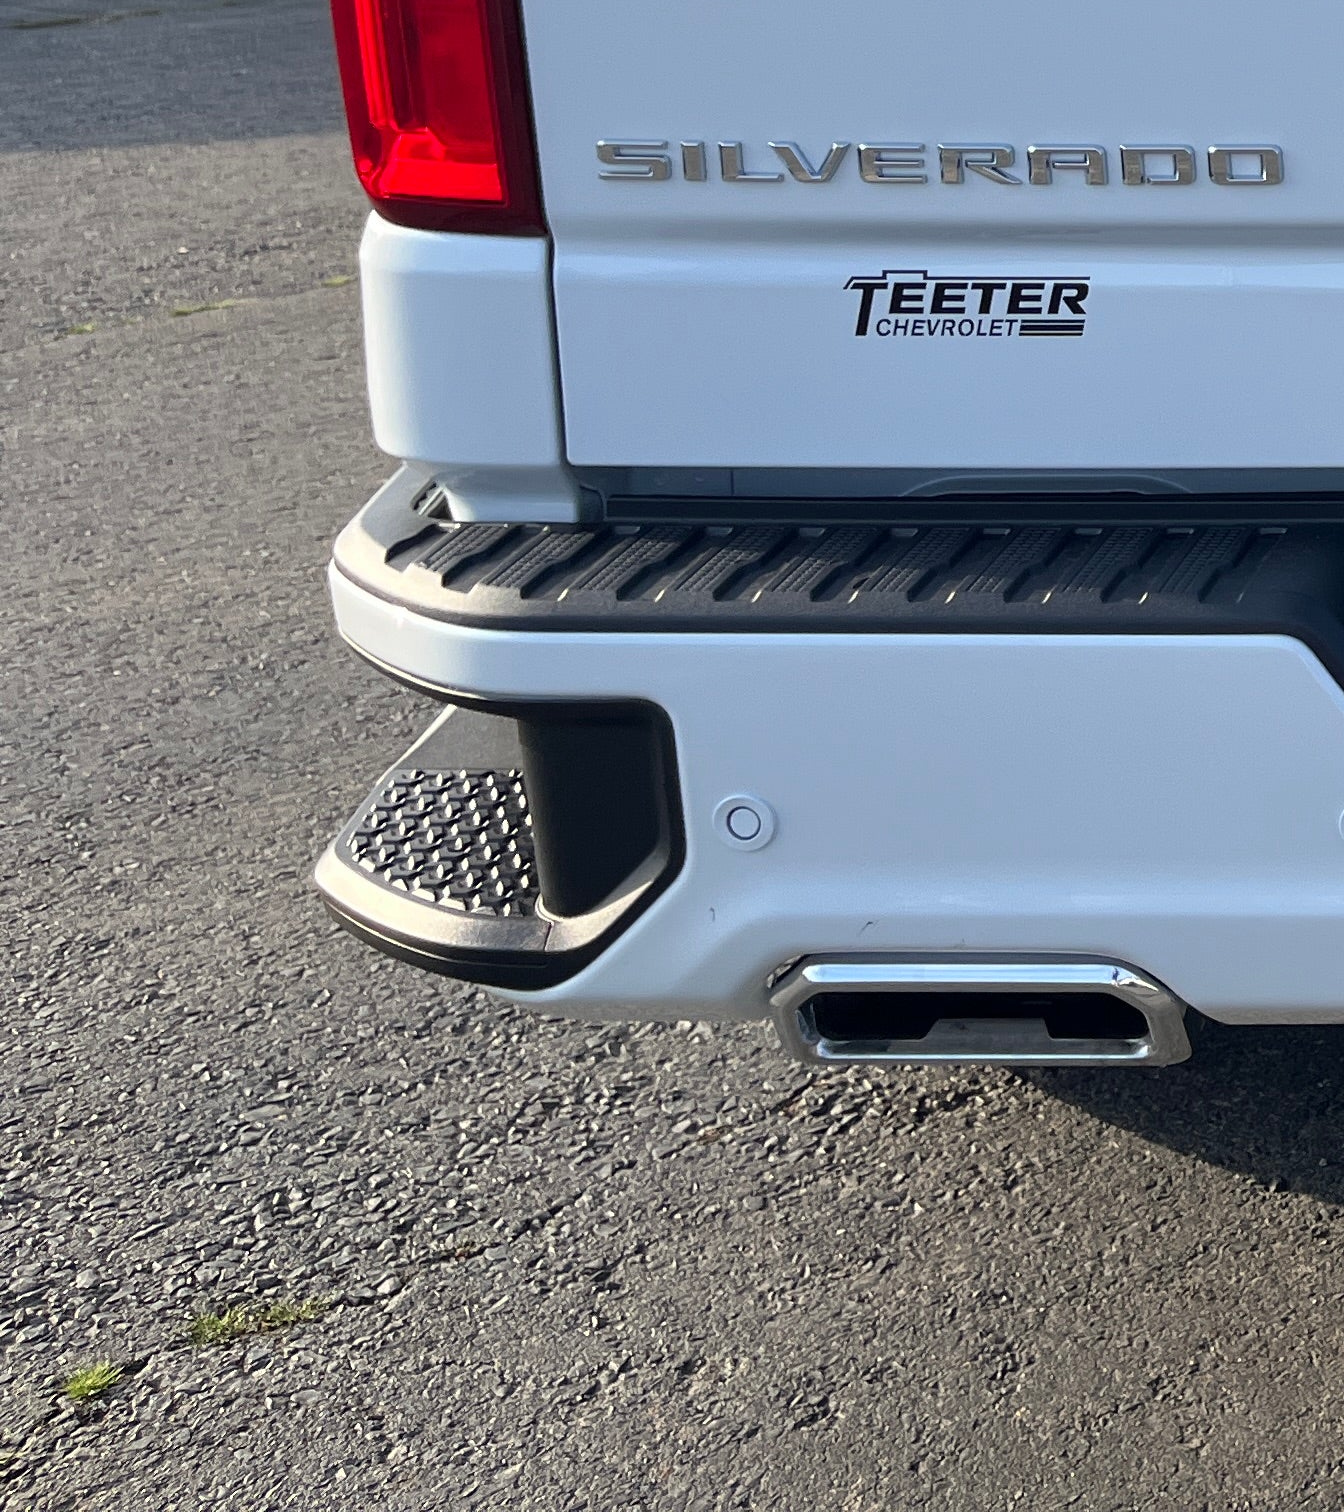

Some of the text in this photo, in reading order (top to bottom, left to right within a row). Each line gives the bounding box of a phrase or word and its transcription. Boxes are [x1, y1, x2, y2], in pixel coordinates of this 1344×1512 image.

[596, 139, 1284, 187] SILVERADO
[849, 282, 1090, 336] TEETER
[876, 318, 1018, 336] CHEVROLET
